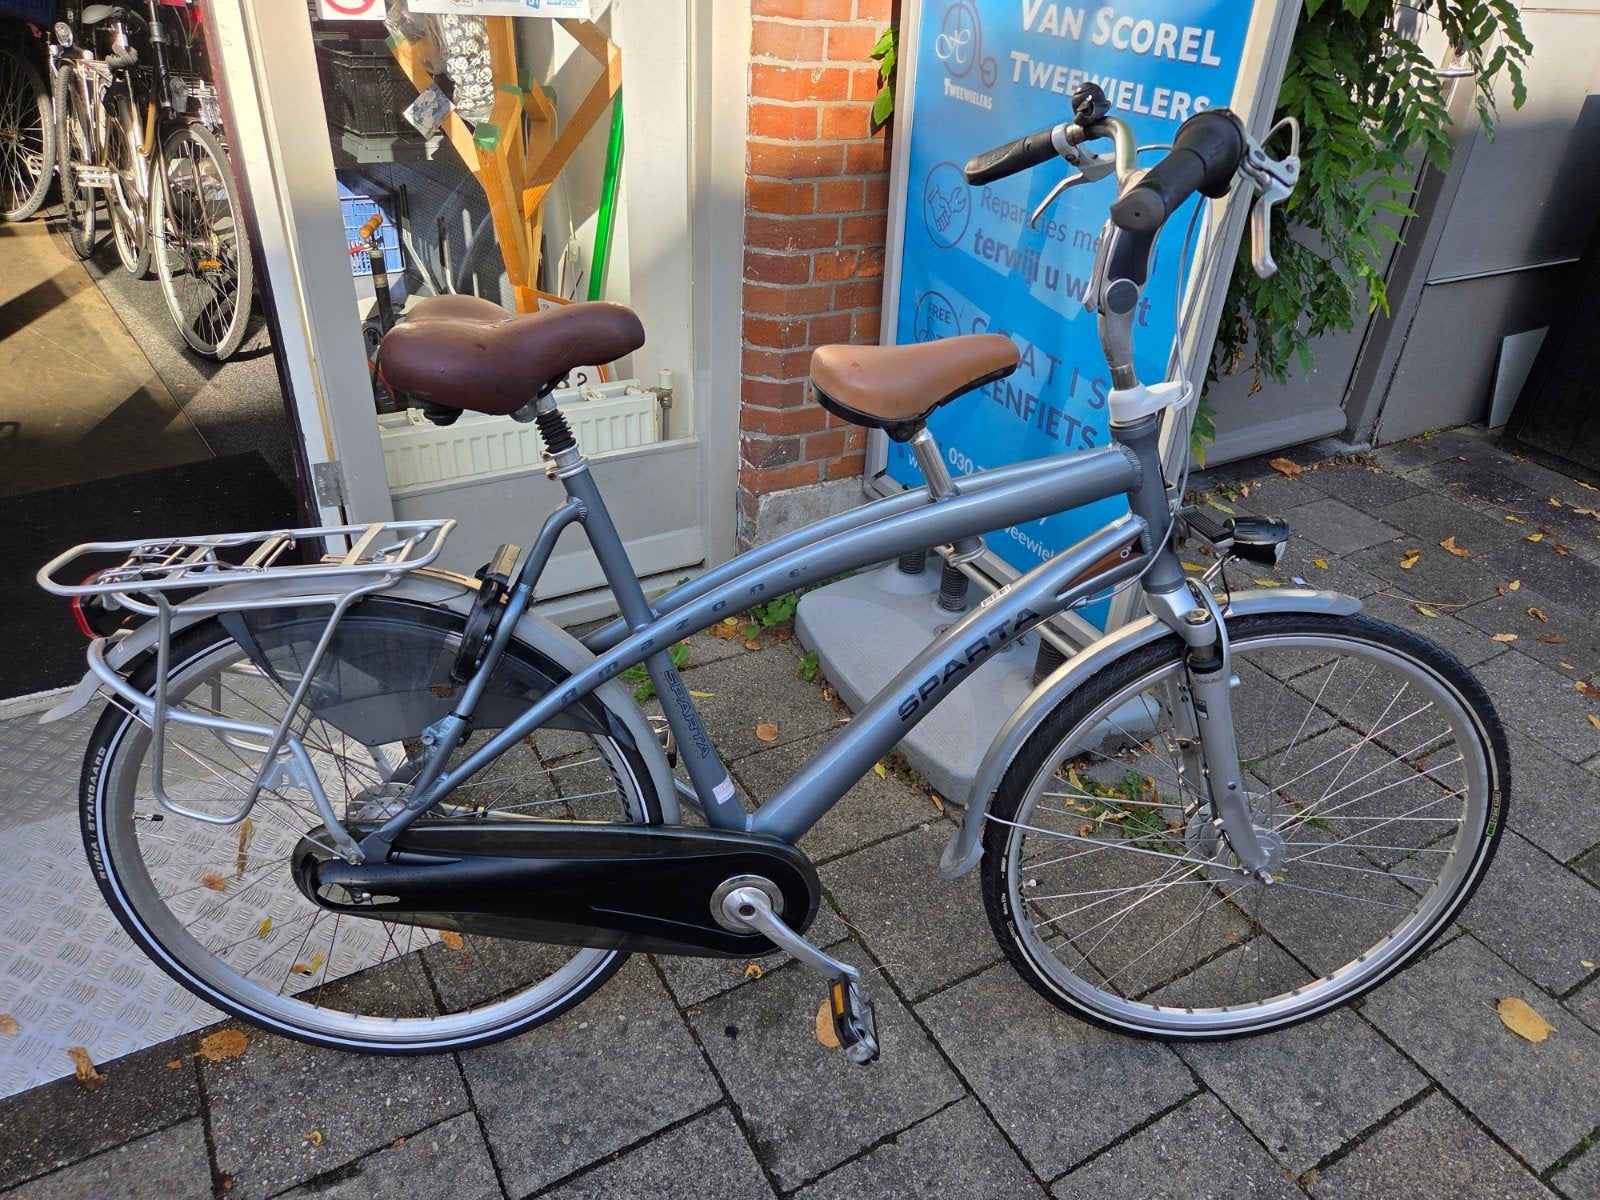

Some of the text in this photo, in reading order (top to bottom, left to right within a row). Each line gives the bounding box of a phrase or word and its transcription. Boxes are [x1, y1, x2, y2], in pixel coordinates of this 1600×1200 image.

[1022, 0, 1221, 67] VAN SCOREL
[943, 77, 993, 110] TWEEWIELERS
[973, 227, 1041, 285] terwijl
[1044, 264, 1060, 292] u
[927, 301, 952, 325] FREE
[980, 378, 1098, 451] ENFIETS
[948, 446, 974, 475] 030
[897, 608, 1042, 723] SPARTA
[662, 667, 711, 760] SPARTA
